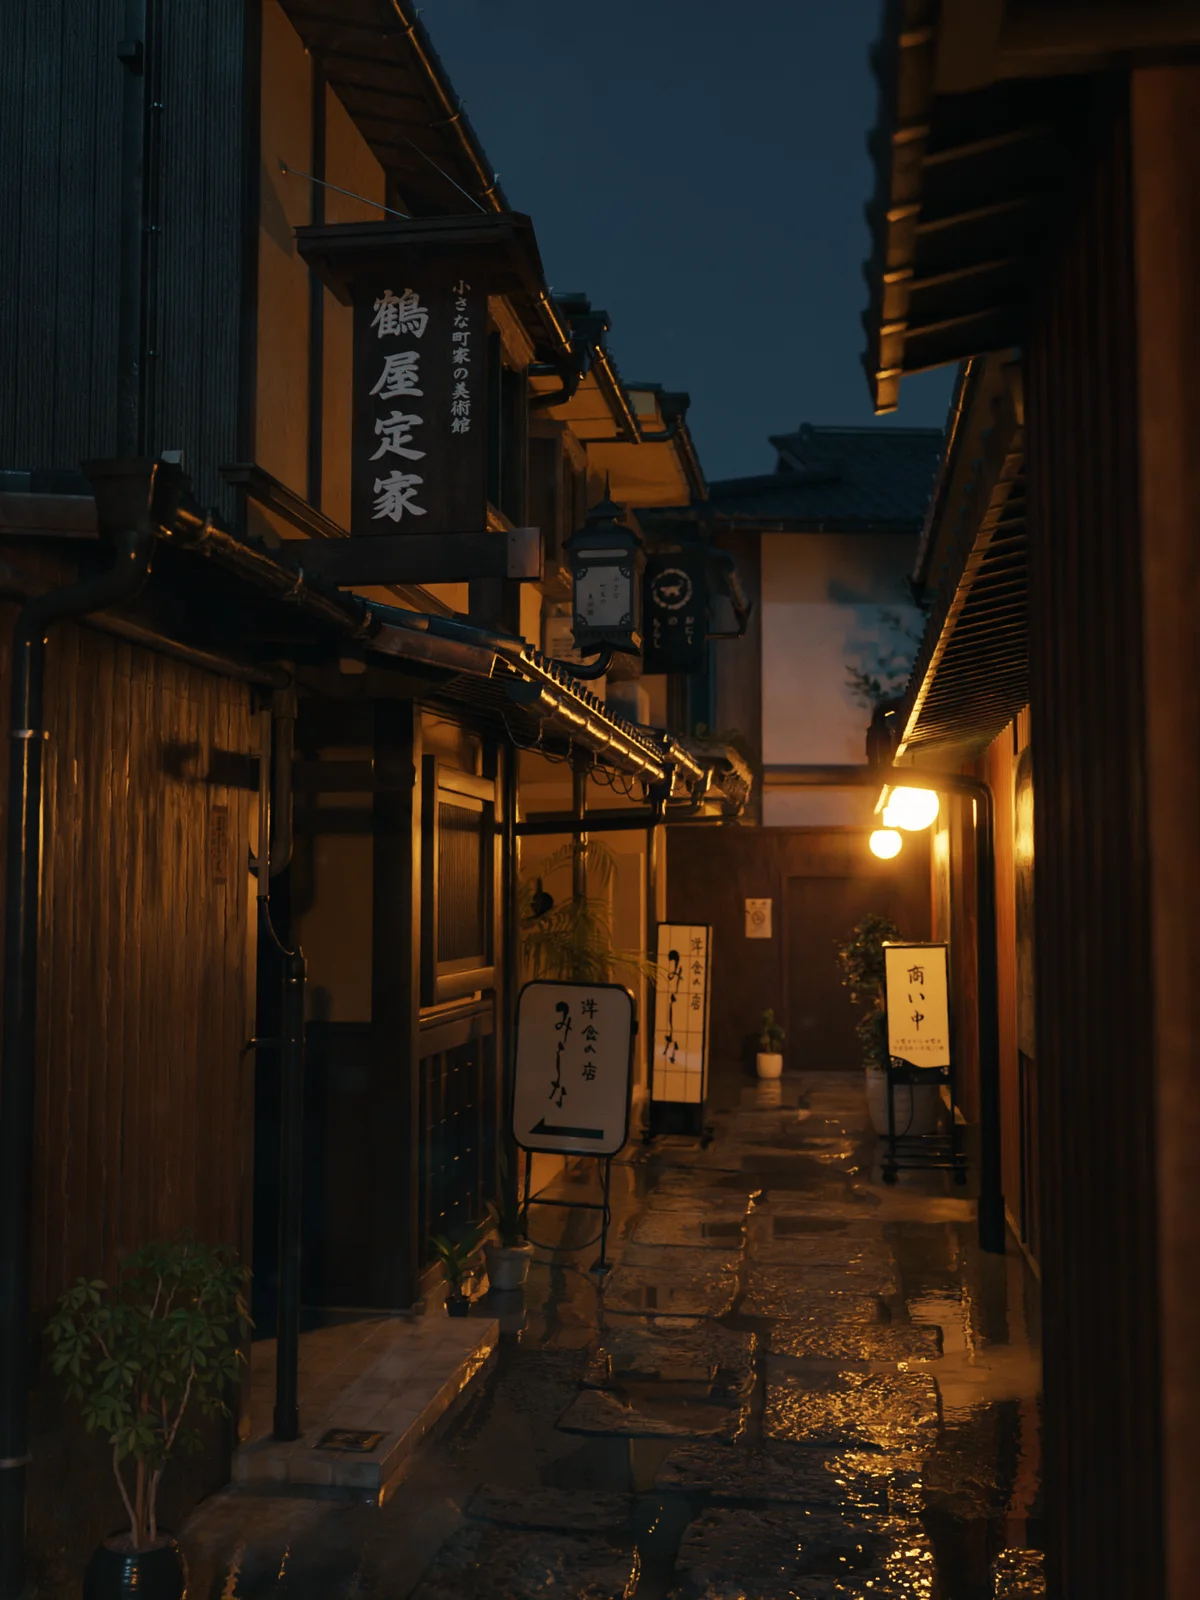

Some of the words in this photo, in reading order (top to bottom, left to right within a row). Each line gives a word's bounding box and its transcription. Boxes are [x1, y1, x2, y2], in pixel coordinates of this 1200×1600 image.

[450, 279, 473, 434] 小さな町家の美術館
[368, 287, 429, 523] 鶴屋定家
[690, 937, 703, 1011] 洋食の店
[907, 965, 925, 1032] 商い中
[581, 999, 599, 1081] 洋食の店
